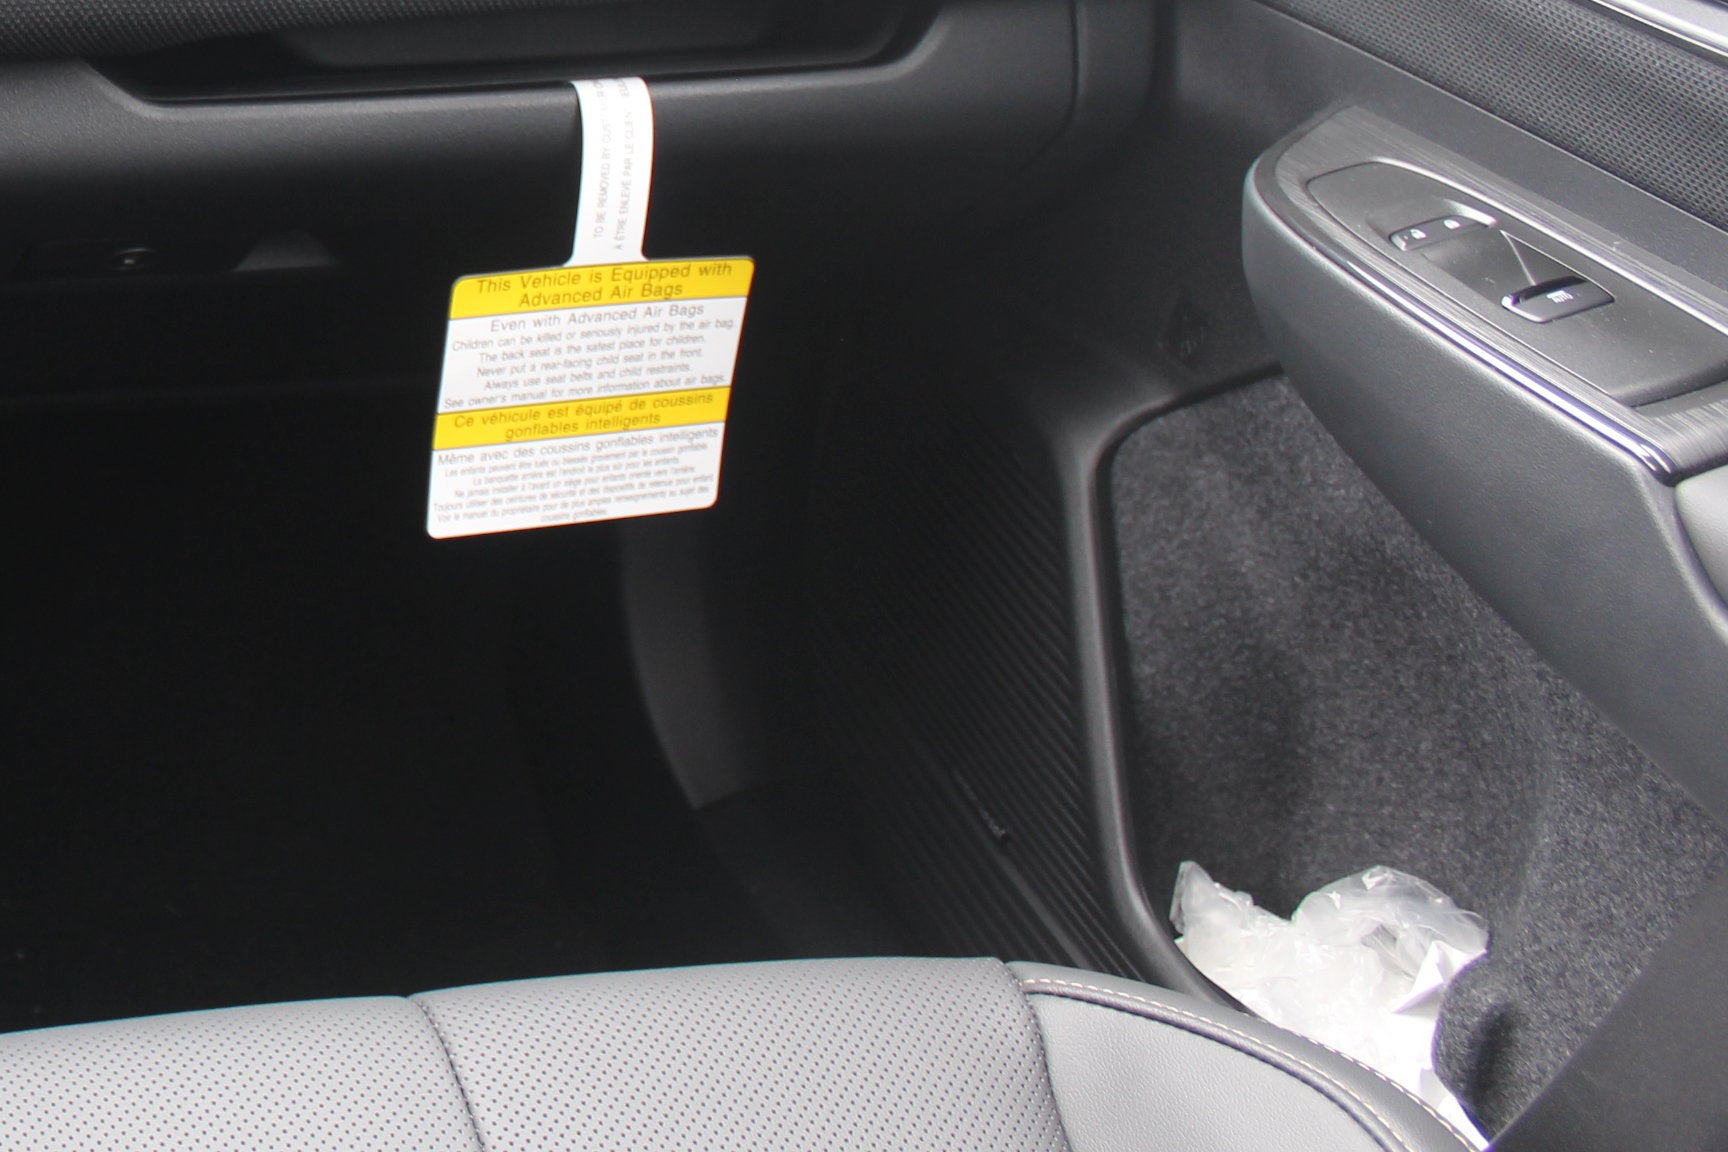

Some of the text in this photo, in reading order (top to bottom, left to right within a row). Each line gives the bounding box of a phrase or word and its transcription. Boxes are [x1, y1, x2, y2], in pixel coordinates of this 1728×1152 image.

[476, 262, 732, 294] This Vehicle is Equipped with
[519, 283, 684, 308] Advanced Air Bags
[490, 304, 704, 333] Even with Advanced Air Bags
[452, 339, 494, 352] Children
[498, 338, 516, 348] can
[520, 334, 532, 345] be
[680, 320, 695, 330] the
[479, 352, 498, 362] The
[529, 348, 550, 358] seat
[566, 344, 582, 354] the
[476, 366, 506, 378] Never
[510, 364, 526, 376] put
[484, 378, 519, 390] Always
[596, 368, 616, 379] and
[444, 398, 464, 409] See
[551, 388, 565, 398] for
[454, 394, 714, 428] Ce véhicule est équipé de coussins
[505, 414, 661, 442] gonflables intelligents
[437, 452, 475, 466] Même
[480, 451, 508, 462] avec
[513, 446, 534, 458] des
[540, 441, 591, 455] coussins
[596, 434, 654, 452] gonflables
[659, 427, 720, 442] intelligents
